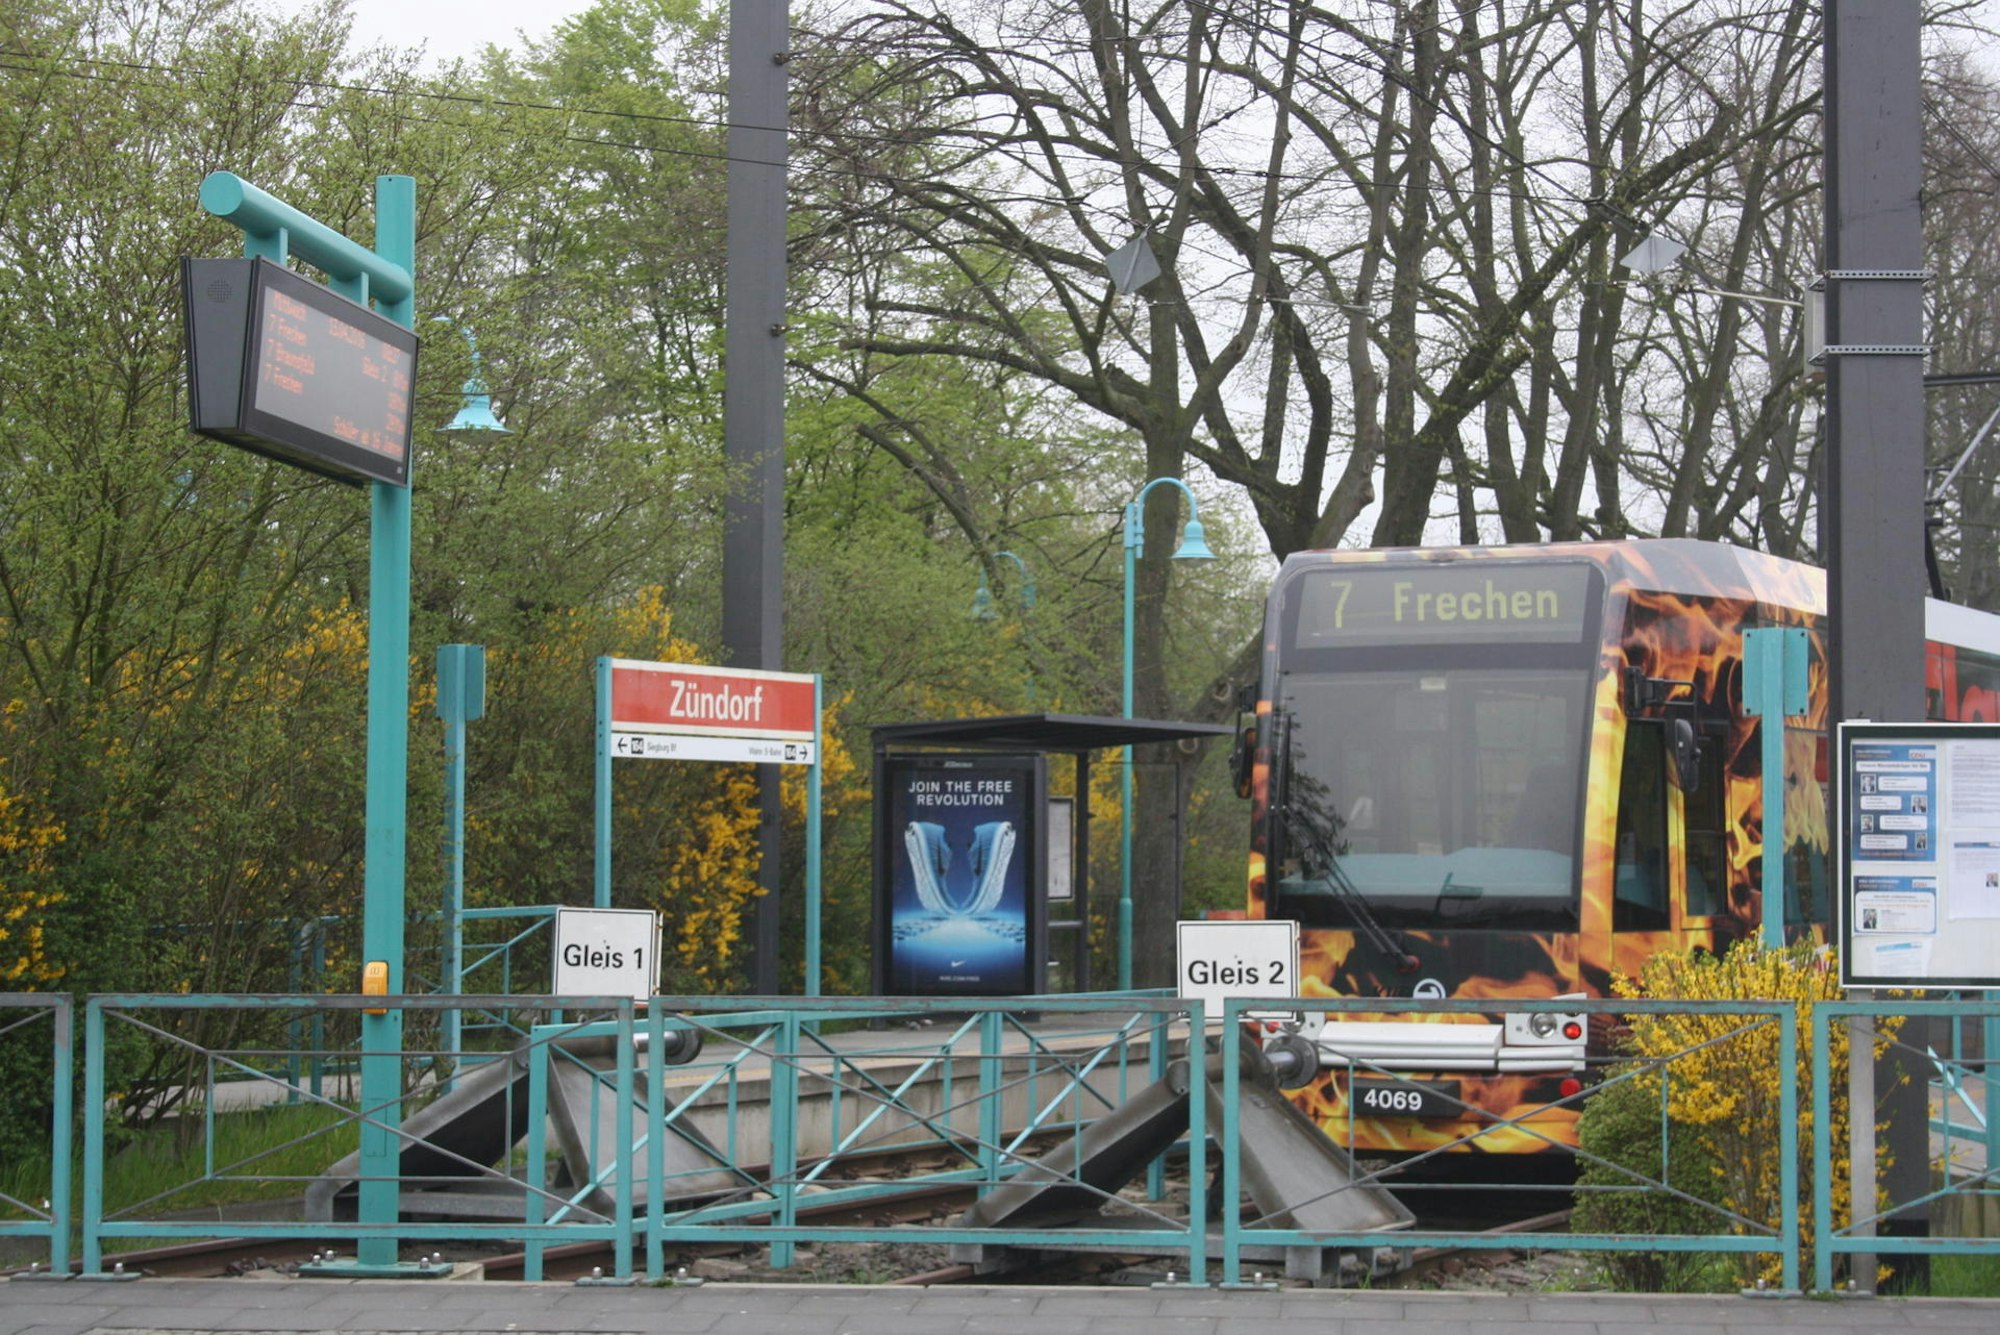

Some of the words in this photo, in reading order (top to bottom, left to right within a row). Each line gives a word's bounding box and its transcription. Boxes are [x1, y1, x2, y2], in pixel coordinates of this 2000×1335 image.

[1331, 581, 1353, 629] 7
[1393, 580, 1559, 622] Frechen
[670, 680, 763, 721] Zündorf
[1910, 752, 1926, 760] CDU
[908, 781, 941, 793] JOIN
[945, 781, 972, 793] THE
[977, 781, 1013, 793] FREE
[916, 794, 1004, 806] REVOLUTION
[564, 944, 623, 968] Gleis
[633, 948, 643, 969] 1
[1188, 960, 1259, 984] Gleis
[1269, 961, 1284, 984] 2
[1364, 1088, 1422, 1110] 4069
